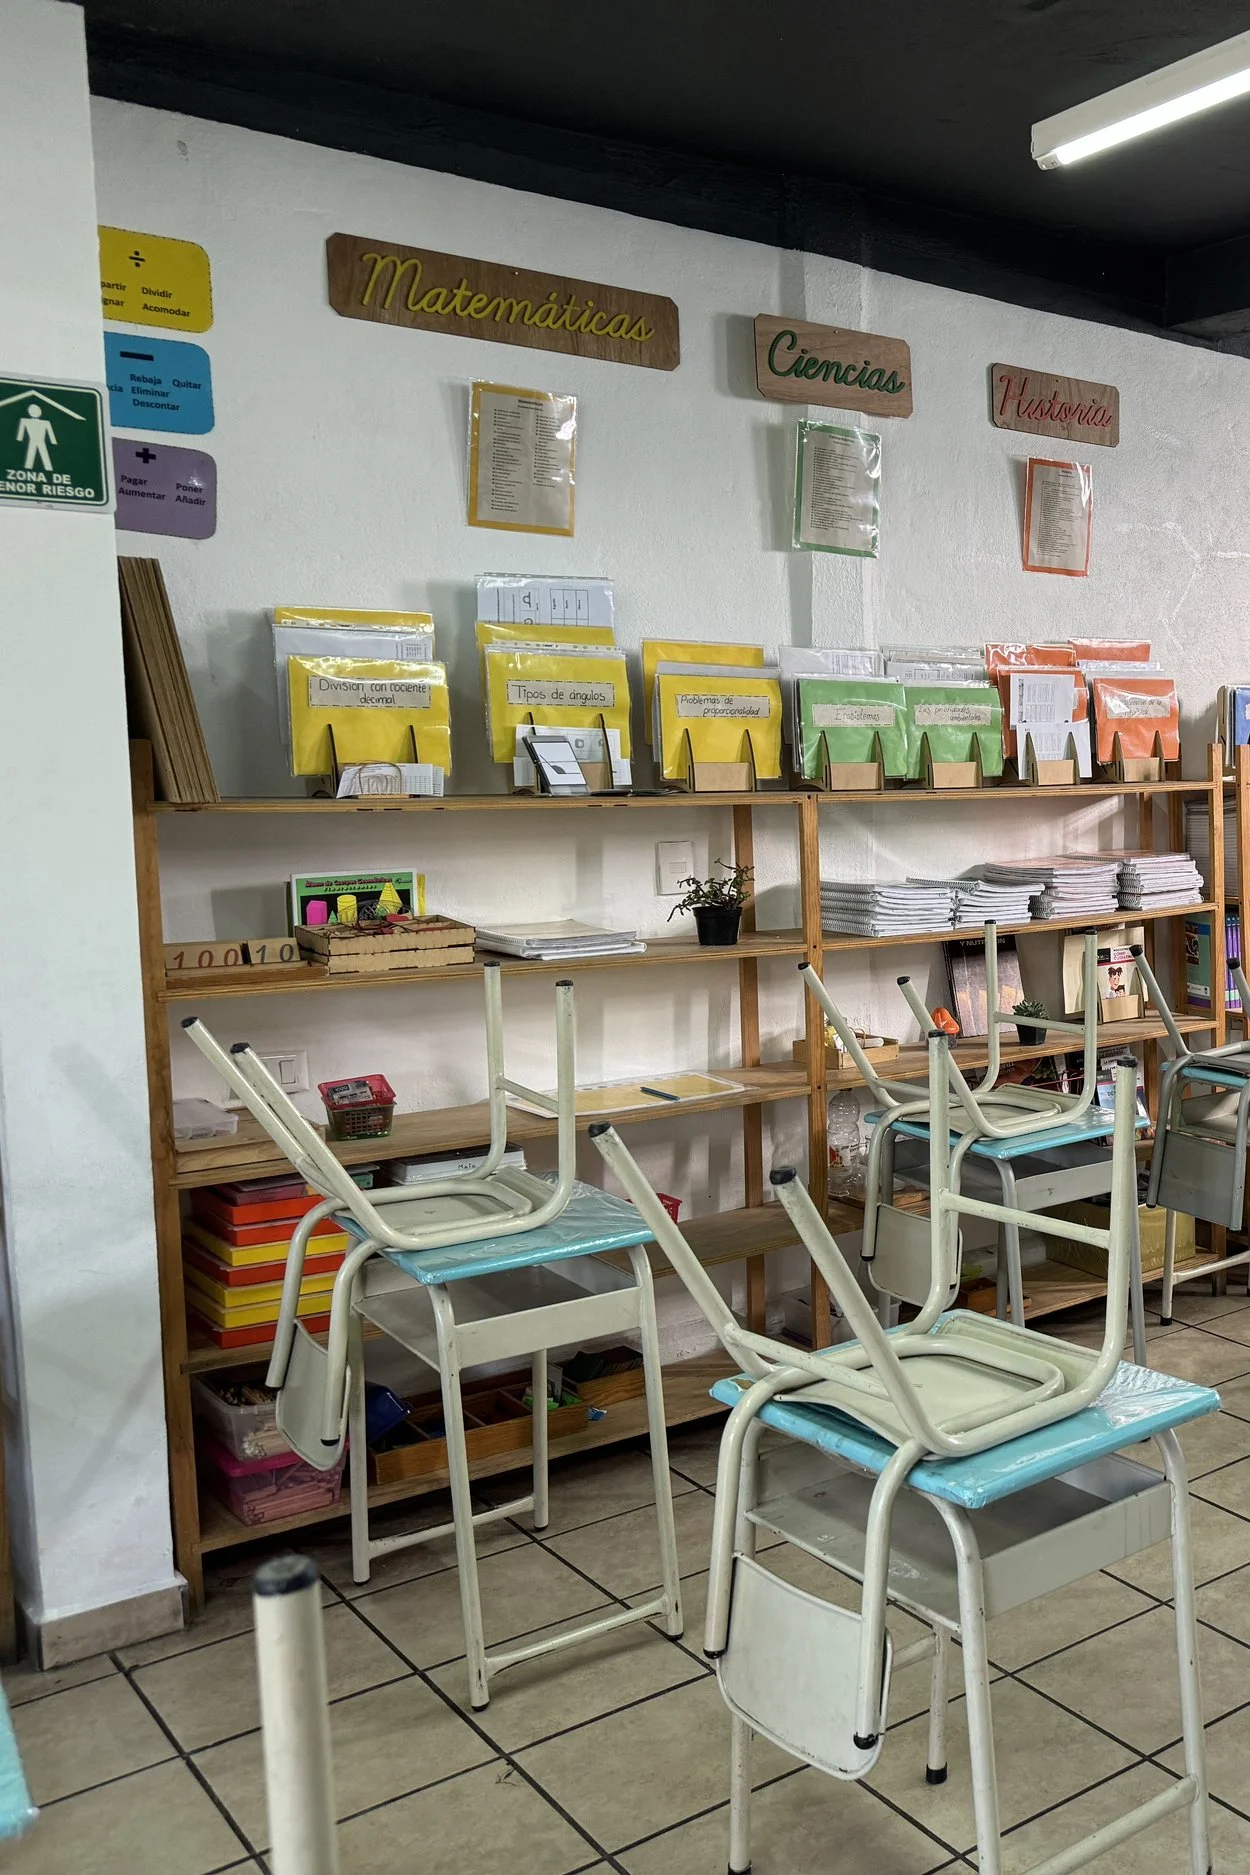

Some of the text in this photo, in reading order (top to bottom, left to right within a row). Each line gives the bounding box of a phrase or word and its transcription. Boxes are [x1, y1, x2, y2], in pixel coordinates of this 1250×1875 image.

[100, 281, 173, 299] partir Dividir
[361, 252, 655, 342] Matemáticas
[102, 297, 191, 317] gnar Acomodar
[767, 329, 905, 395] Ciencias
[129, 373, 202, 390] Rebaja Quitar
[131, 386, 170, 398] Eliminar
[1000, 374, 1113, 428] Historia
[132, 398, 180, 411] Descontar
[6, 469, 71, 485] ZONA DE
[120, 475, 203, 494] Pagar Poner
[0, 480, 95, 498] ENOR RIESGO
[118, 487, 206, 506] Aumentar Añadir
[370, 682, 387, 692] con
[511, 684, 606, 704] Tipos de ángulos
[359, 693, 396, 705] decimal
[680, 695, 733, 705] Problemas de
[703, 706, 760, 717] proporcionalidad
[834, 708, 880, 721] Ecosistemas
[173, 948, 240, 969] 100
